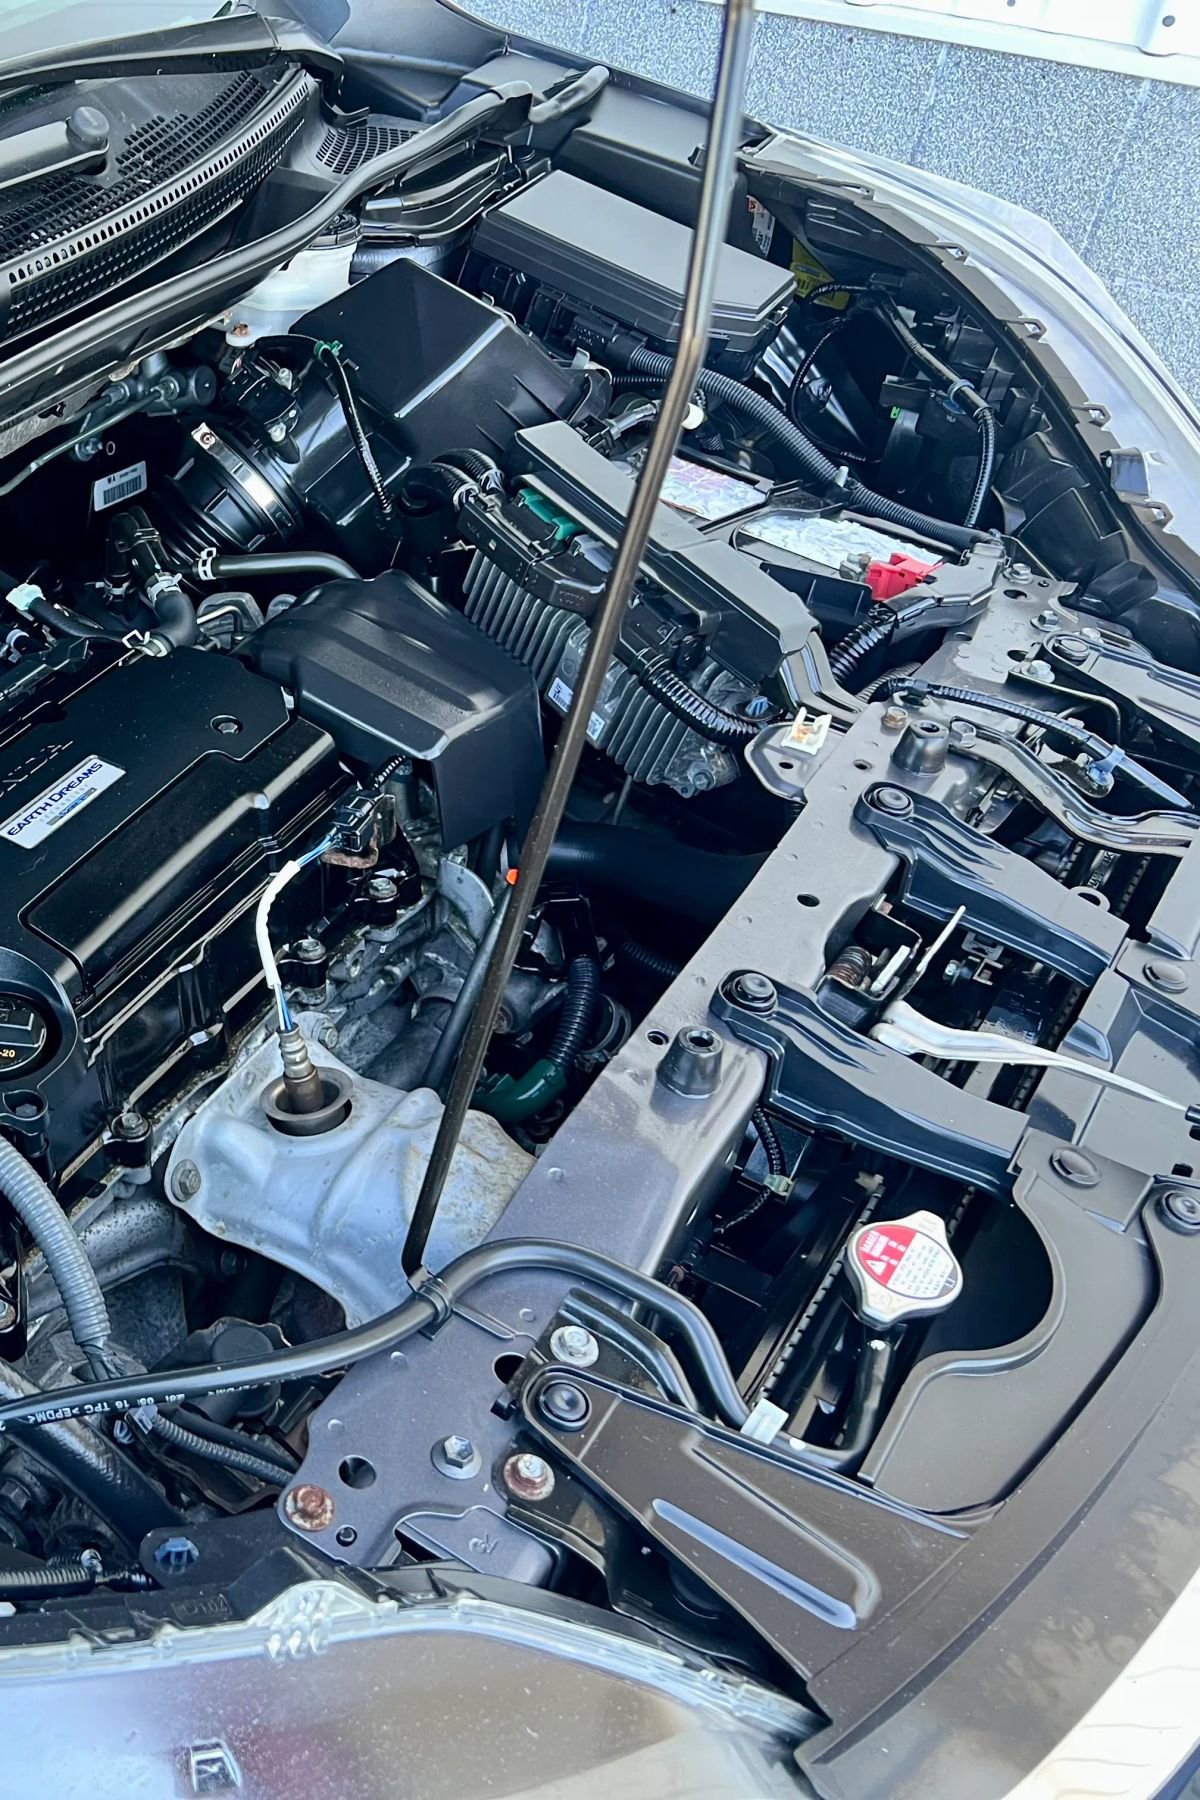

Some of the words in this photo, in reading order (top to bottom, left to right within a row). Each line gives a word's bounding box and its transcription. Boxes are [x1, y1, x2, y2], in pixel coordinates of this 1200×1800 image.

[7, 802, 53, 836] EARTH
[47, 762, 103, 803] DREAMS
[83, 1402, 111, 1414] TPC
